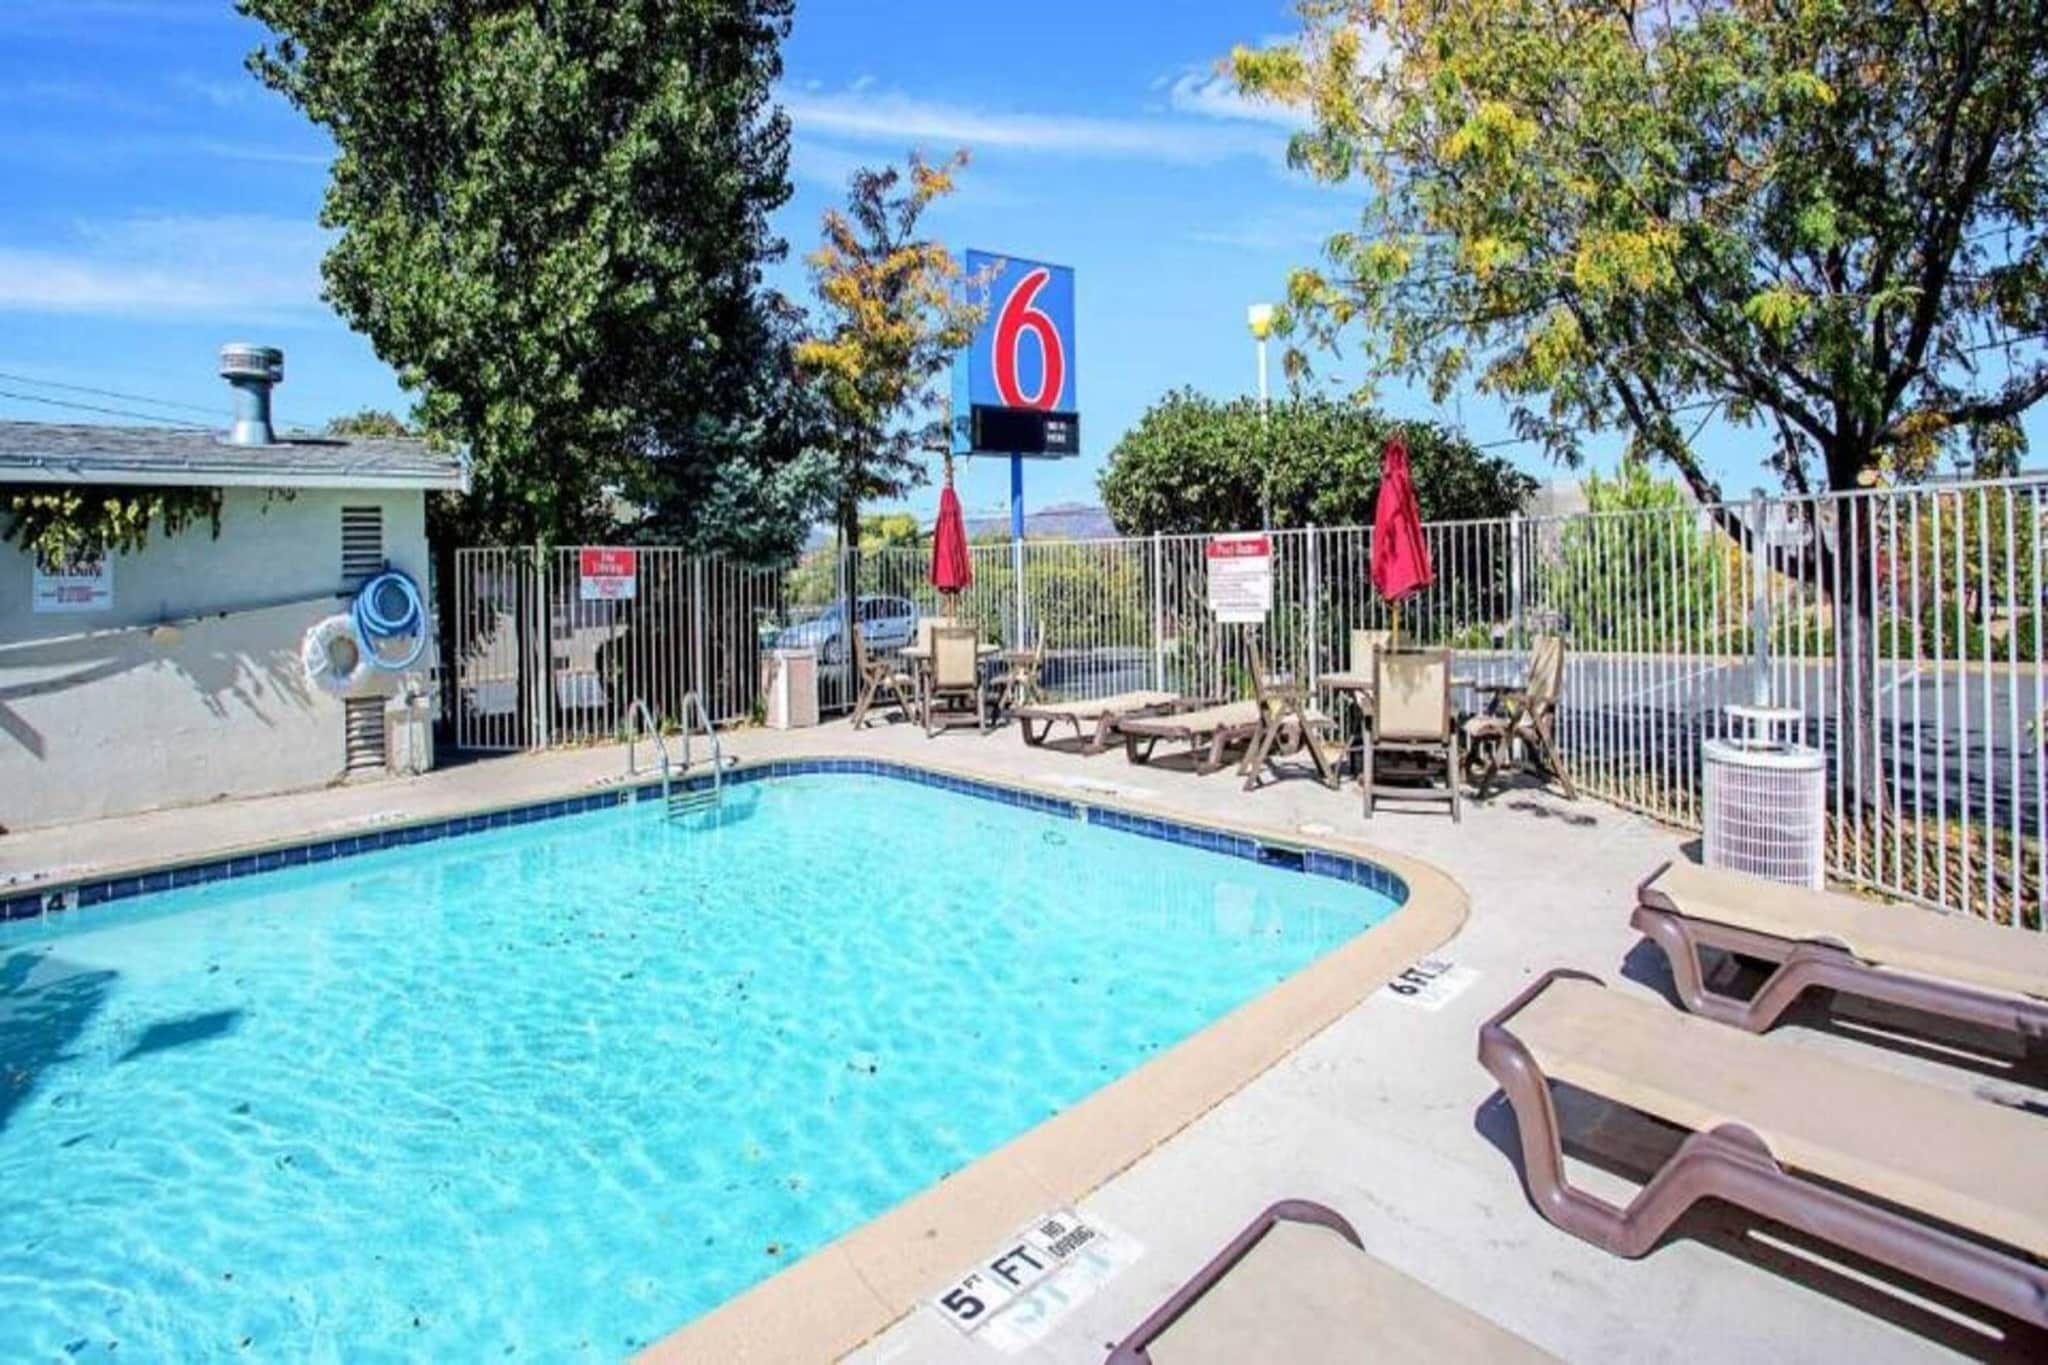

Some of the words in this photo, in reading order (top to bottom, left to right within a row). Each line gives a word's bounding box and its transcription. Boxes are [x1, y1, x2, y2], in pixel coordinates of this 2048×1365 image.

[992, 267, 1065, 411] 6
[990, 1245, 1043, 1286] FT
[941, 1288, 985, 1320] 5
